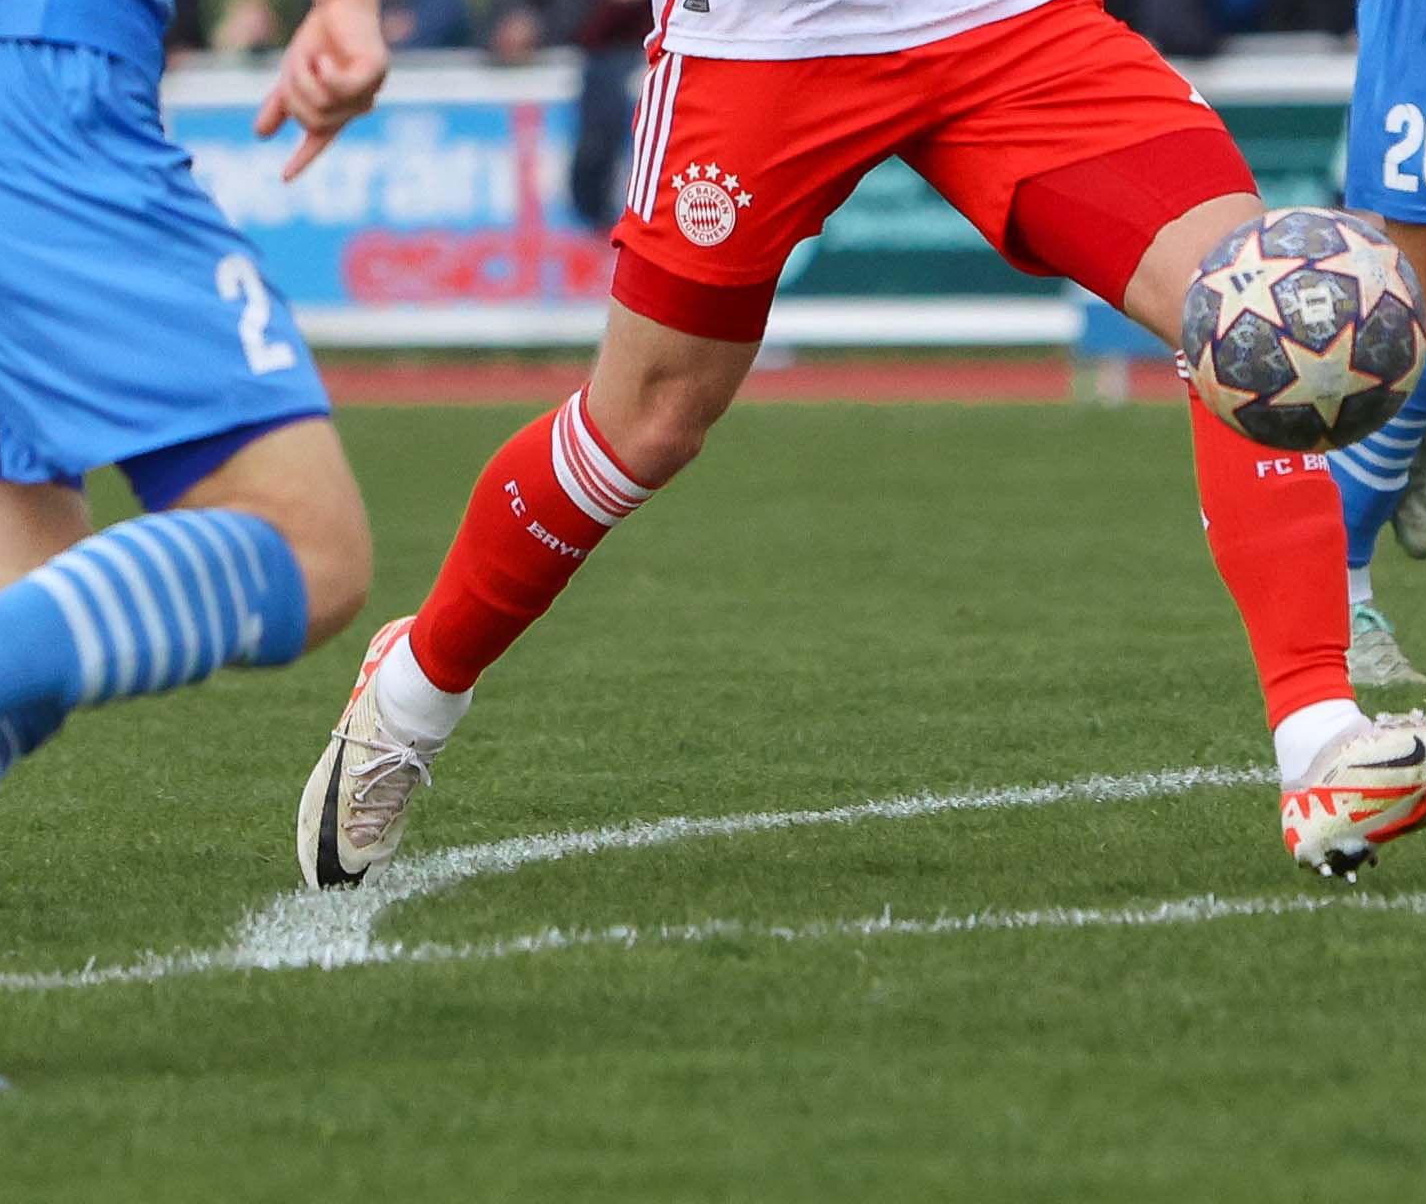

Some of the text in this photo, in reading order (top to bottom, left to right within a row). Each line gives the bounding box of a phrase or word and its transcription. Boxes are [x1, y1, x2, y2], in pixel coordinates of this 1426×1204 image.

[683, 187, 730, 215] FC BAYERN
[215, 252, 296, 375] 2
[1256, 458, 1293, 479] FC
[504, 480, 527, 518] FC
